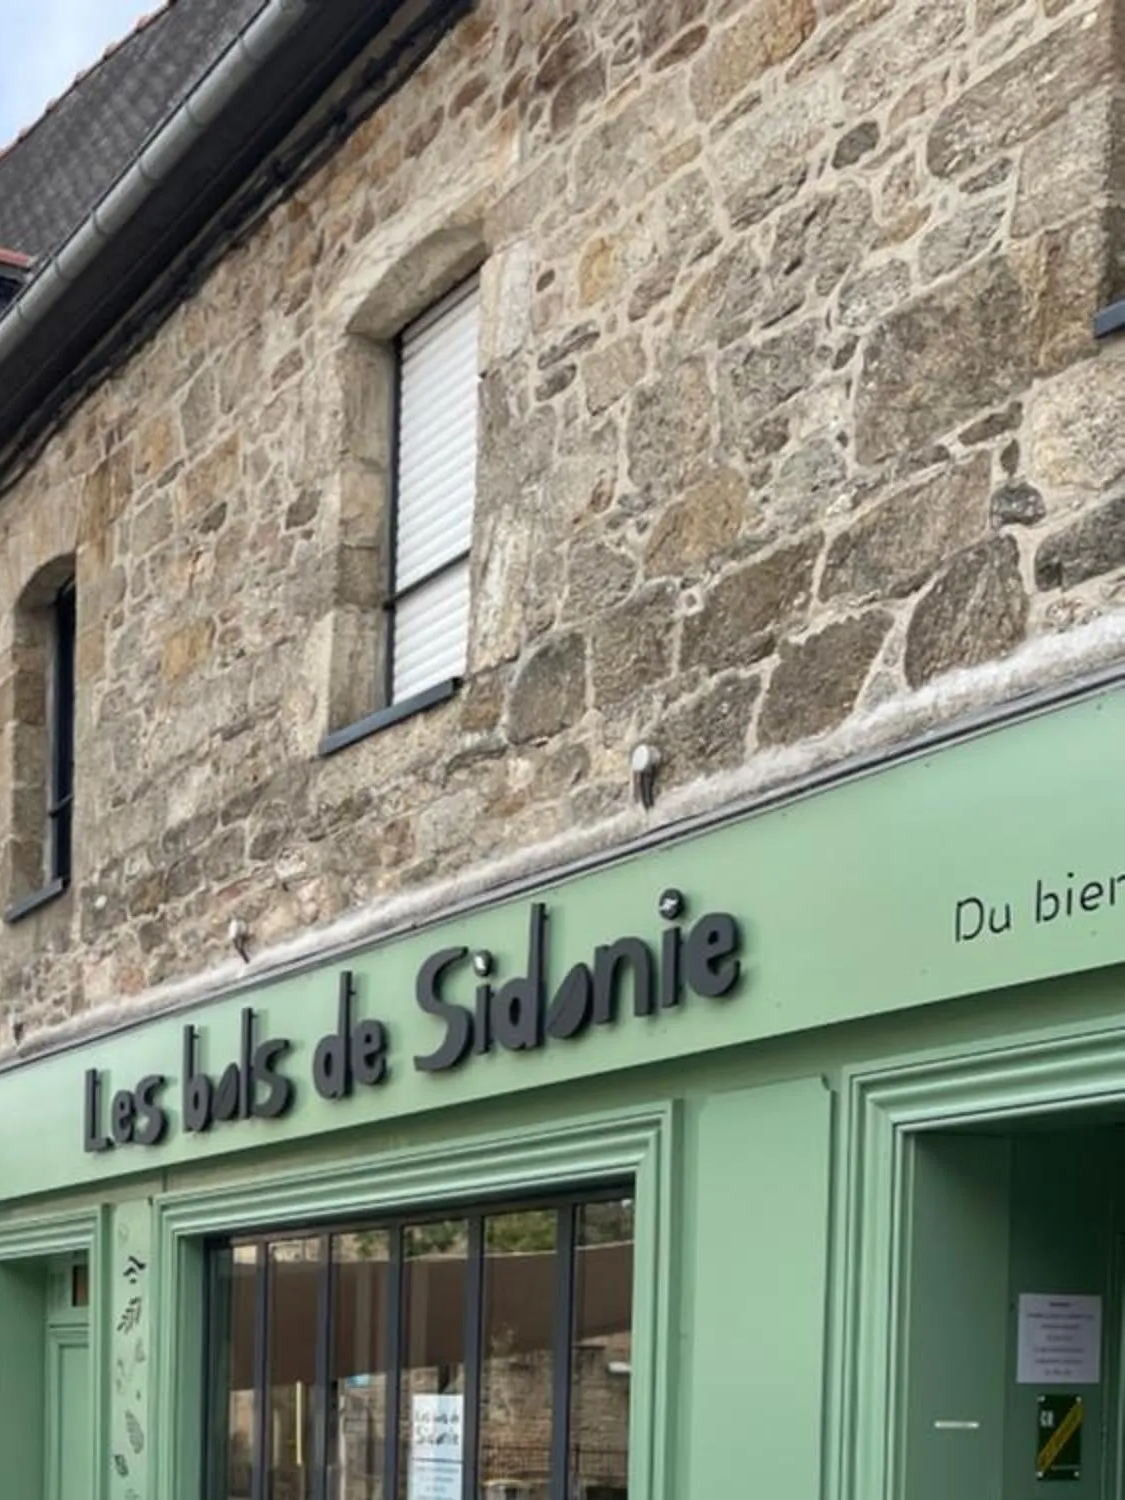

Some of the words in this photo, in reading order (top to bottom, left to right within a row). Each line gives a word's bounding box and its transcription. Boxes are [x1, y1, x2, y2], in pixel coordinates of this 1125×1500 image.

[955, 896, 1011, 943] Du
[84, 1067, 167, 1152] Les
[182, 1006, 295, 1132] bols
[312, 970, 387, 1101] de
[414, 888, 741, 1072] Sidonie
